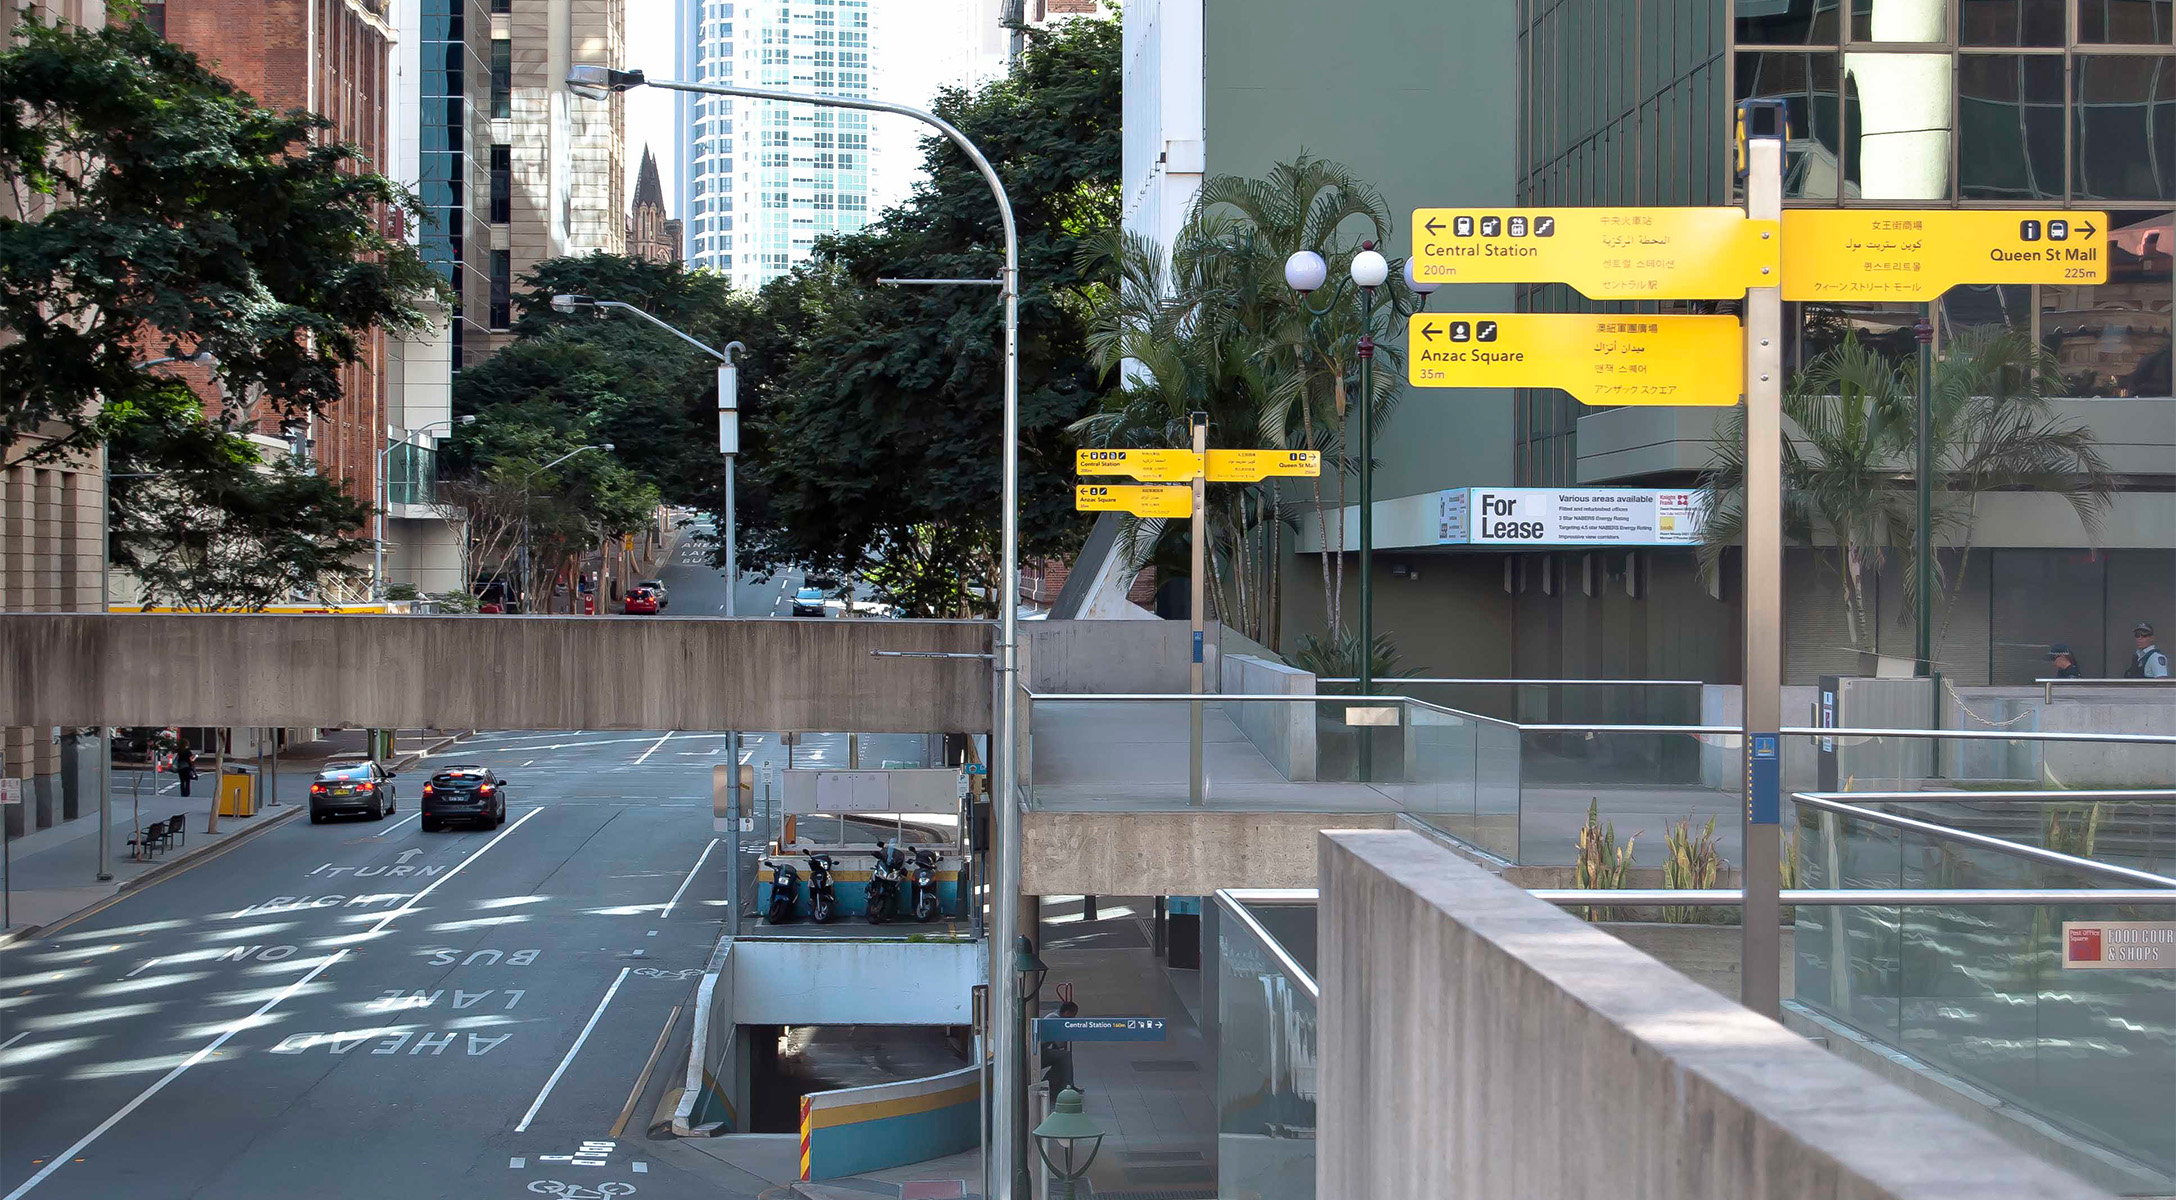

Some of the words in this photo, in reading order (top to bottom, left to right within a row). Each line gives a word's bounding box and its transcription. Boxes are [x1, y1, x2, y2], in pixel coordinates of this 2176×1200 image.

[1872, 220, 1923, 231] 女王街商場
[1424, 243, 1480, 257] Central
[1485, 243, 1538, 257] Station
[1990, 248, 2041, 261] Queen
[2045, 248, 2061, 261] St
[2065, 247, 2097, 261] Mall
[1423, 265, 1457, 275] 200m
[2064, 268, 2097, 278] 225m
[1420, 349, 1467, 362] Anzac
[1471, 348, 1524, 366] Square
[1420, 368, 1445, 379] 35m
[1482, 494, 1517, 517] For
[1558, 494, 1590, 502] Various
[1616, 495, 1654, 503] available
[1482, 516, 1544, 539] Lease
[326, 865, 446, 878] TURN
[254, 893, 418, 909] RIGHT
[2107, 929, 2138, 944] FOOD
[2142, 929, 2175, 944] COUR
[215, 945, 299, 962] NO
[428, 949, 542, 966] BUS
[2107, 946, 2116, 961] &
[2119, 946, 2160, 961] SHOPS
[365, 989, 527, 1010] LANE
[269, 1032, 514, 1056] AHEAD
